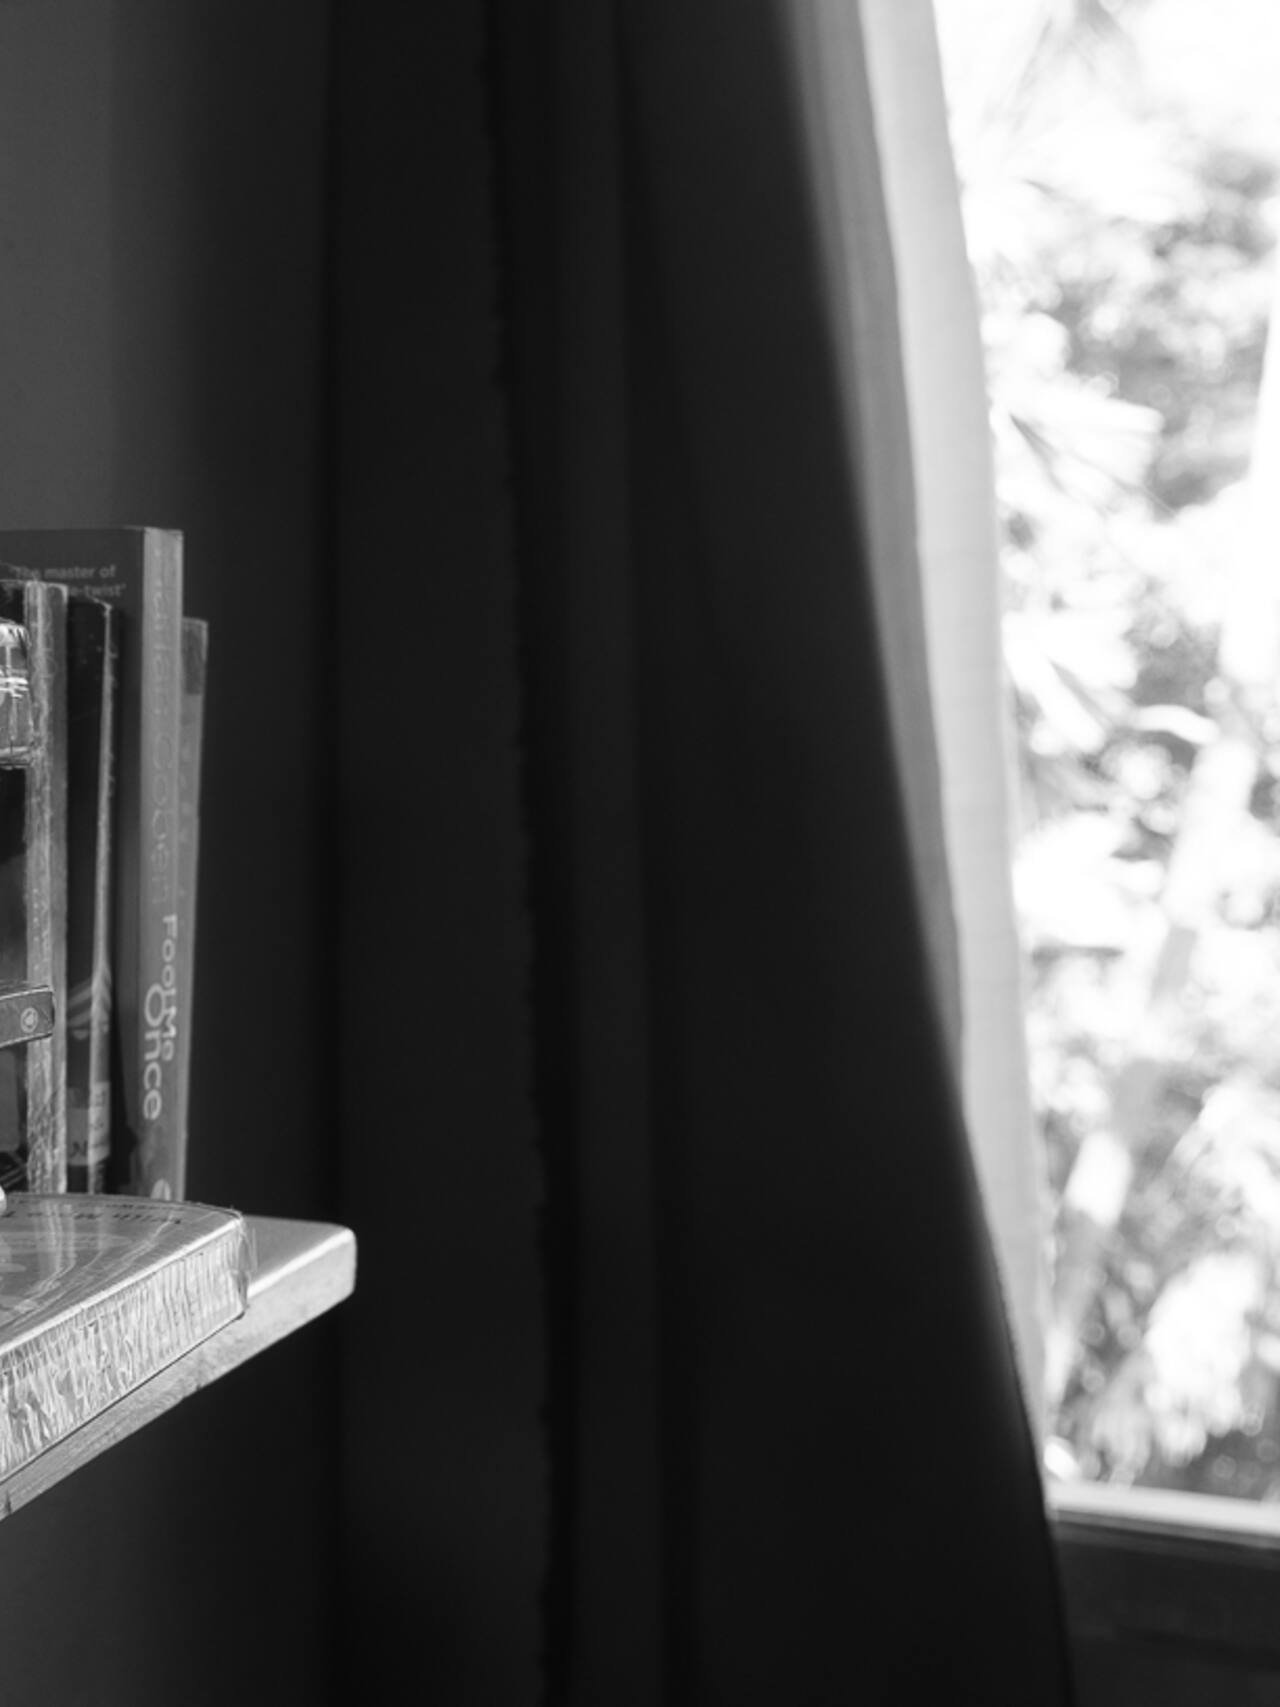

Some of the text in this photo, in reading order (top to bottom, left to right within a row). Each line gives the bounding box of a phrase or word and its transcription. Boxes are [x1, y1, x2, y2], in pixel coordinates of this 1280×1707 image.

[44, 566, 95, 579] master
[99, 564, 117, 579] of
[143, 983, 168, 1120] Once
